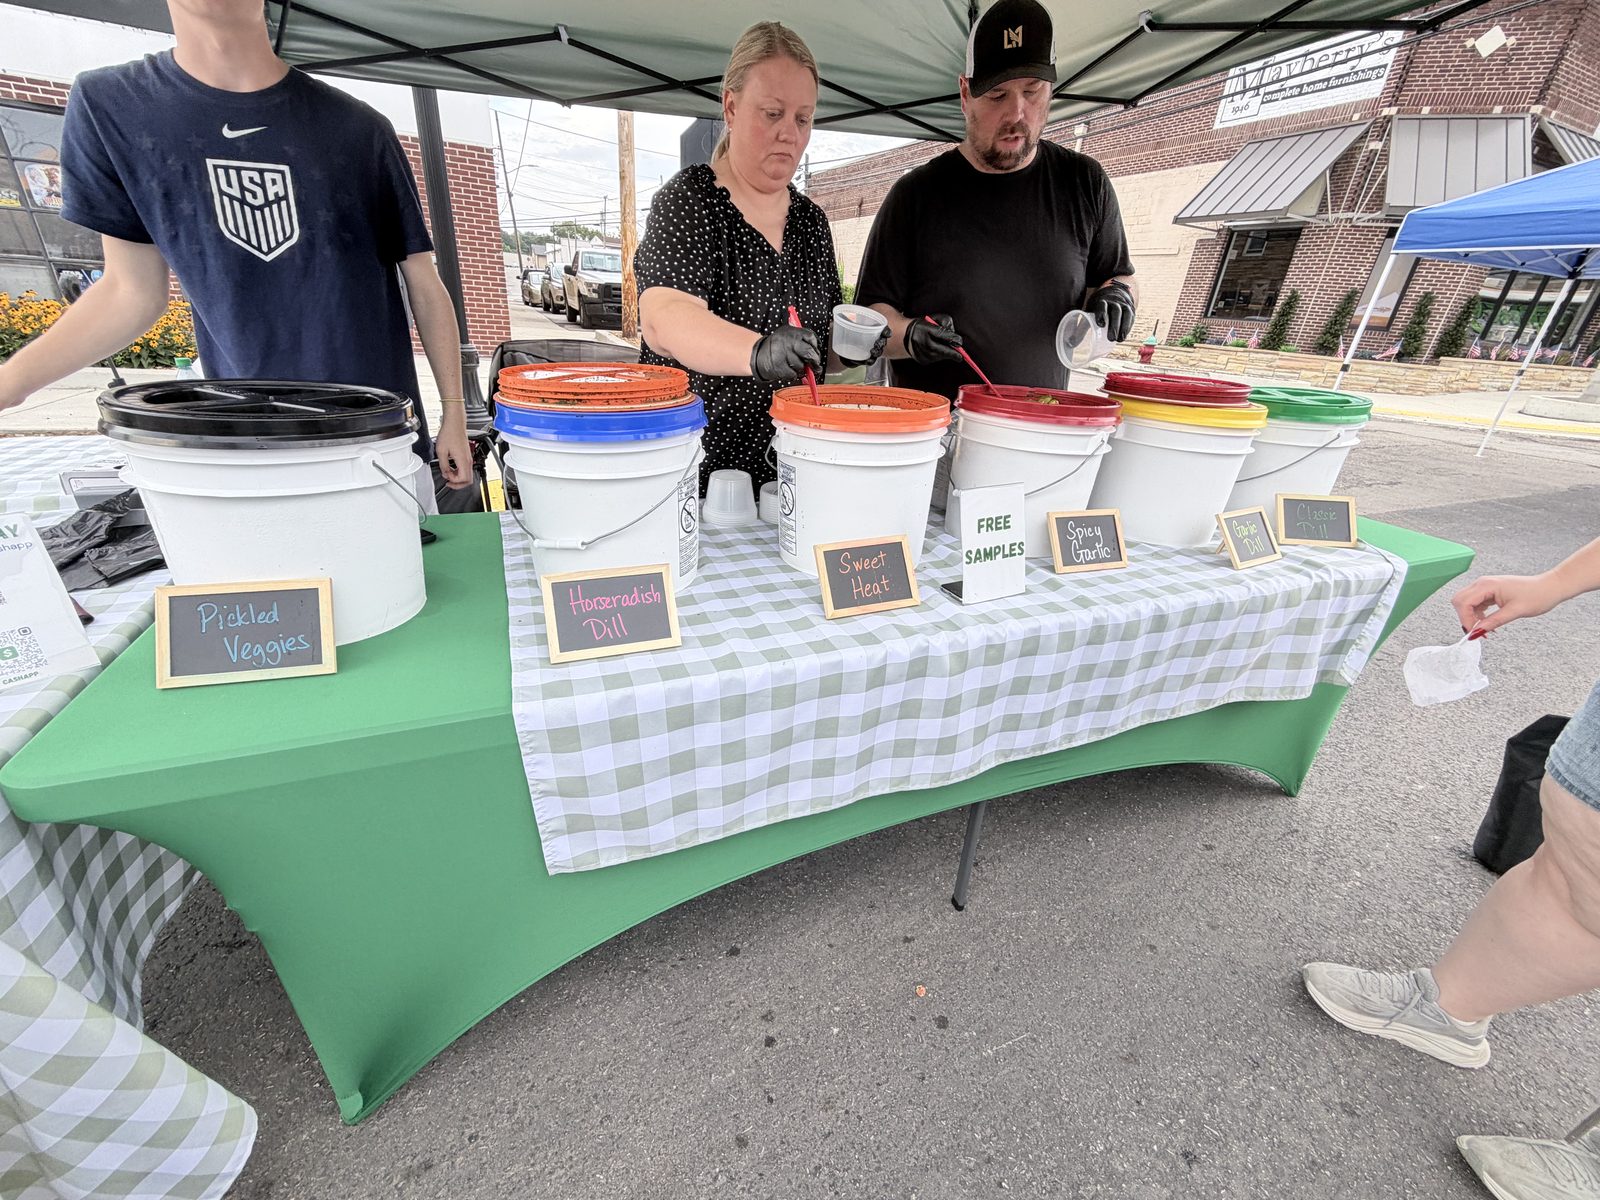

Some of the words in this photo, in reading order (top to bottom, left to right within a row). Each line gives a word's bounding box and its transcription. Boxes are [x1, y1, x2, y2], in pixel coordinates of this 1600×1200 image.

[1262, 85, 1302, 101] complete
[1301, 80, 1328, 94] home
[1328, 66, 1386, 87] furnishings
[1231, 101, 1251, 115] 1946
[216, 167, 286, 207] USA
[1296, 502, 1337, 521] Classic
[977, 514, 1012, 534] FREE
[1066, 520, 1104, 547] Spicy
[1232, 520, 1258, 539] Garlic
[1296, 521, 1329, 539] Dill
[964, 541, 1025, 566] SAMPLES
[1071, 540, 1111, 564] Garlic
[1242, 535, 1265, 556] Dill
[838, 551, 887, 574] Sweet
[569, 583, 662, 616] Horseradish
[851, 575, 890, 600] Heat
[196, 601, 280, 633] Pickled
[582, 613, 629, 641] Dill
[223, 633, 312, 668] Veggies
[2, 670, 39, 685] CASHAPP
